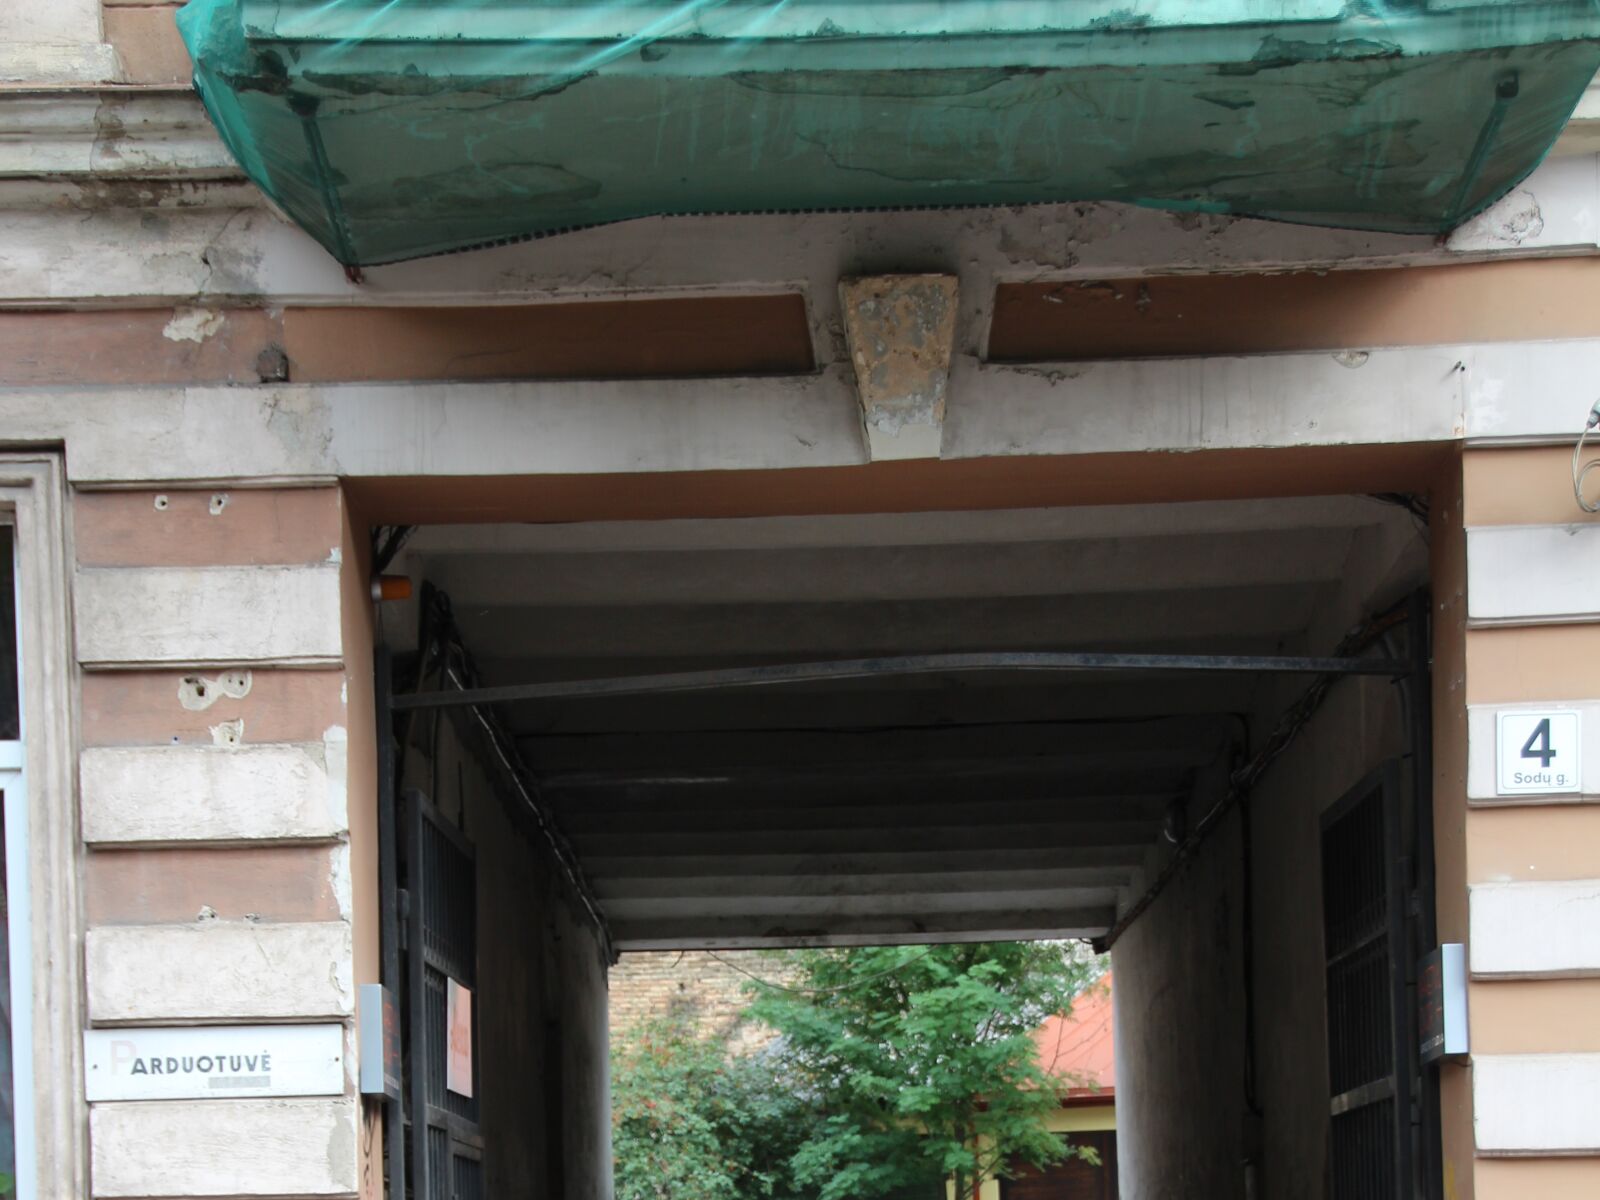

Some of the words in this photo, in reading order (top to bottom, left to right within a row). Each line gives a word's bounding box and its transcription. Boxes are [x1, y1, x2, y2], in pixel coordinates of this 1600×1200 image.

[1519, 717, 1557, 768] 4
[1513, 771, 1551, 787] Sodų
[1555, 773, 1569, 786] g.
